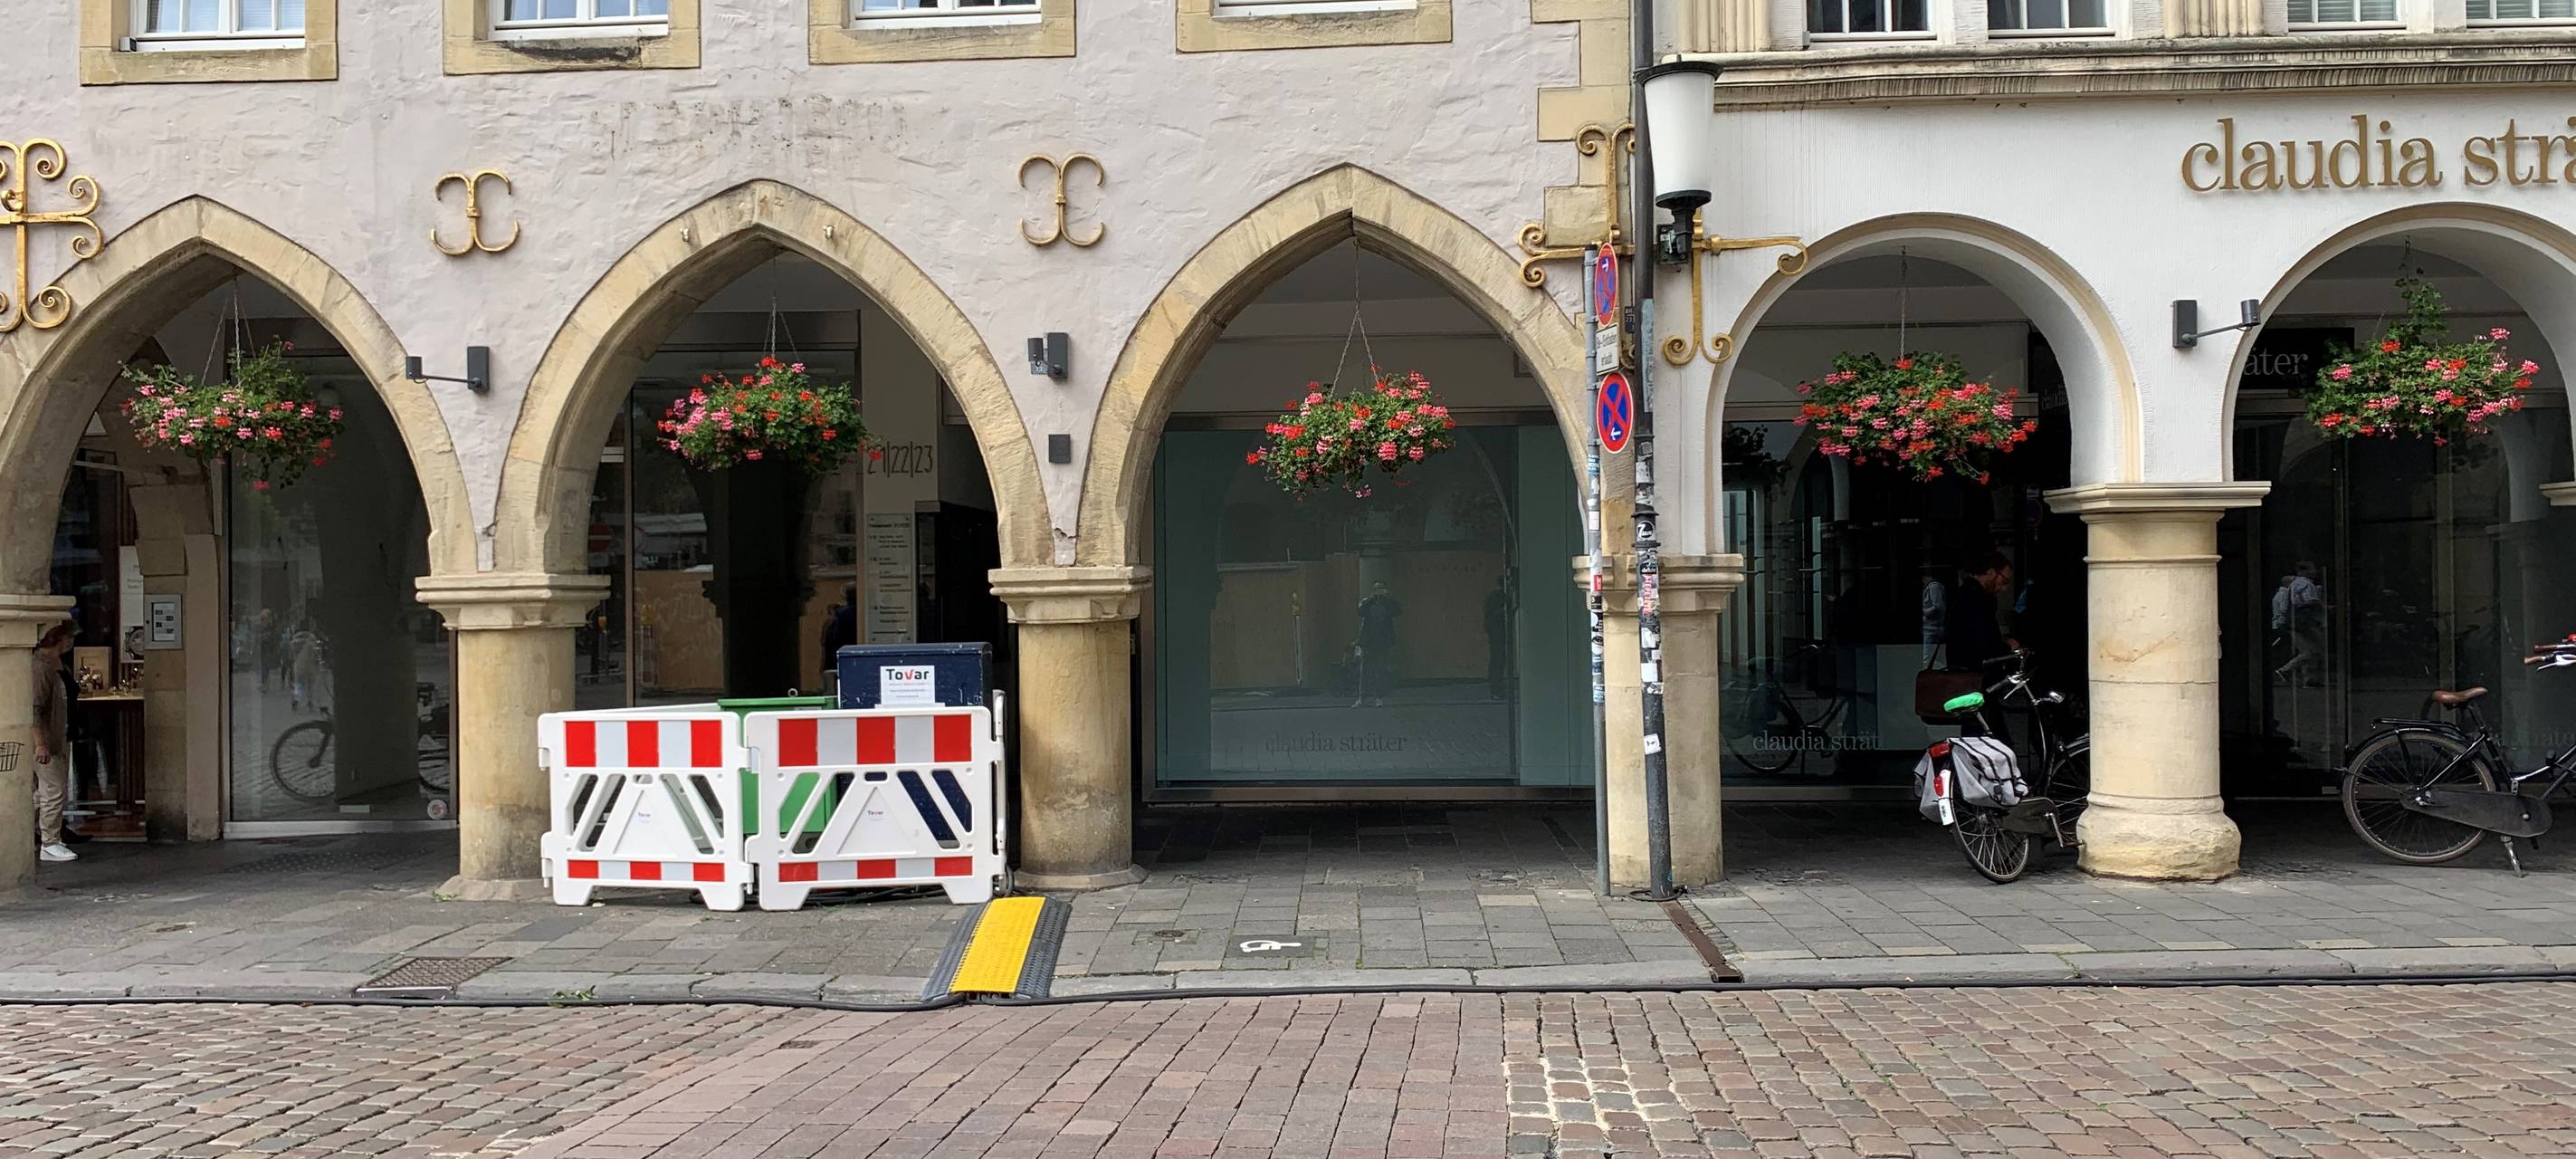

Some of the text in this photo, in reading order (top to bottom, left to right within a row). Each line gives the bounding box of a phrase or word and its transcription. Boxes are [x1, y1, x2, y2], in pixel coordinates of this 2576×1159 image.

[2181, 114, 2444, 192] claudia
[885, 668, 930, 680] Tovar
[1265, 731, 1406, 752] claudia sträter
[1753, 730, 1826, 751] claudia
